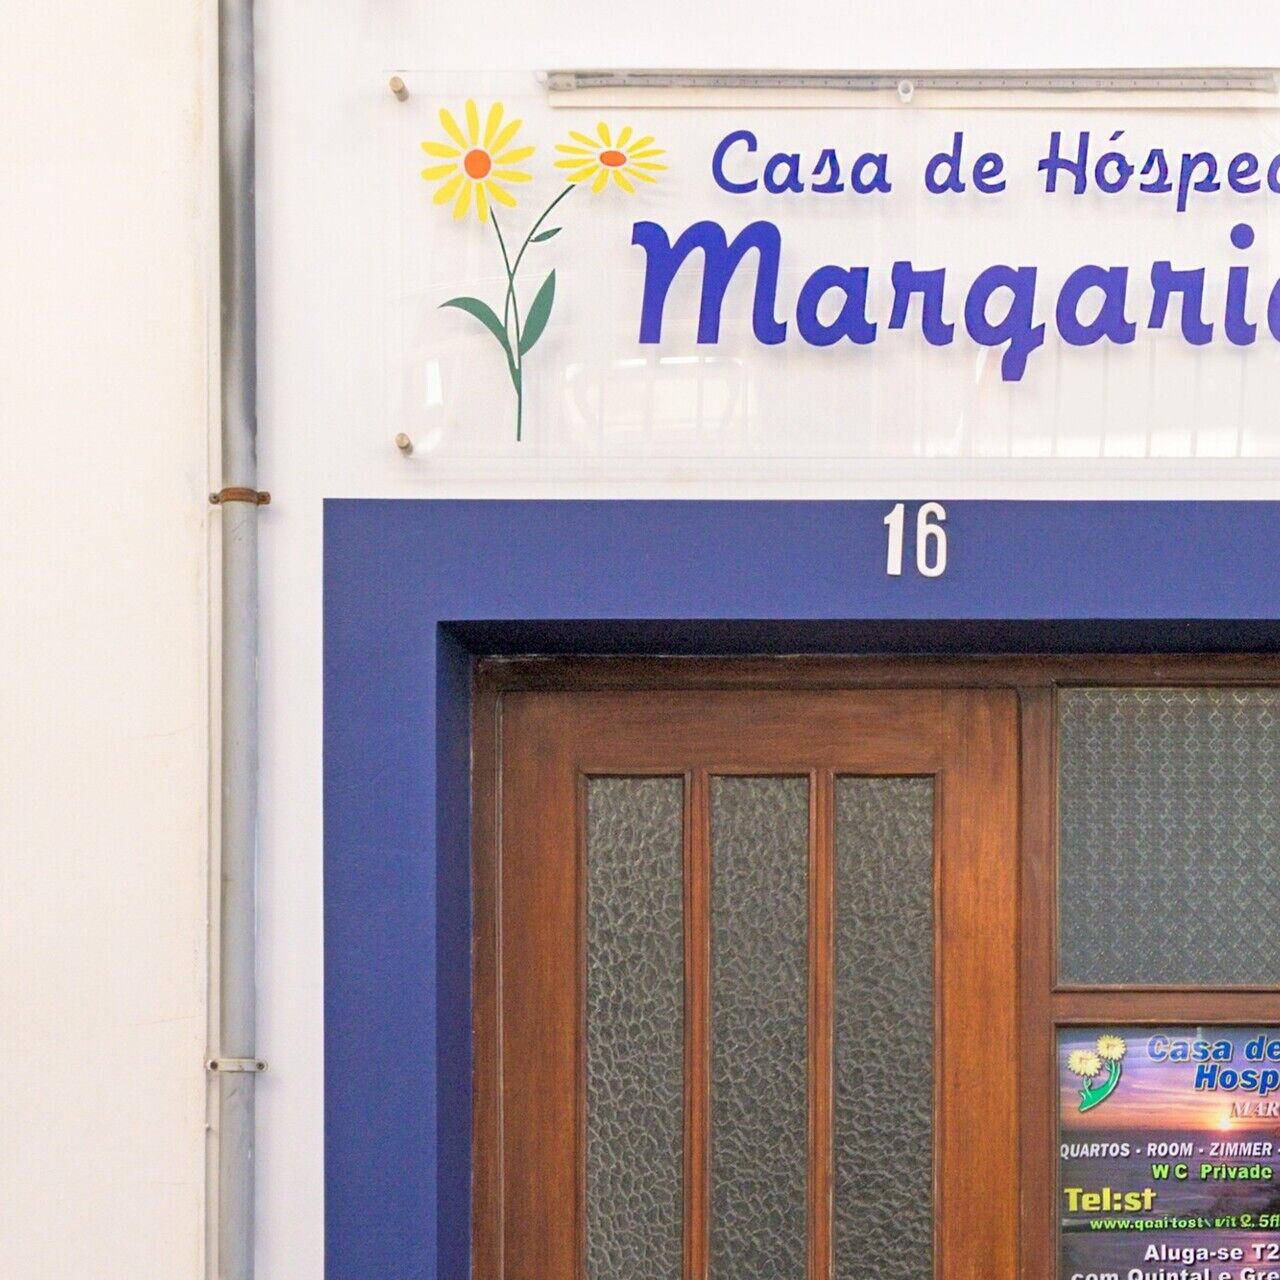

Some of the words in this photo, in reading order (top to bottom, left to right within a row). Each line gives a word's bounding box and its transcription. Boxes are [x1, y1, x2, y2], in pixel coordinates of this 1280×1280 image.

[711, 129, 892, 194] Casa
[924, 131, 1006, 194] de
[883, 501, 949, 578] 16
[1146, 1034, 1233, 1062] Casa
[1060, 1143, 1130, 1160] QUARTOS
[1147, 1143, 1193, 1156] ROOM
[1209, 1143, 1273, 1156] ZIMMER
[1144, 1244, 1243, 1264] Aluga-se
[1252, 1243, 1280, 1260] T2
